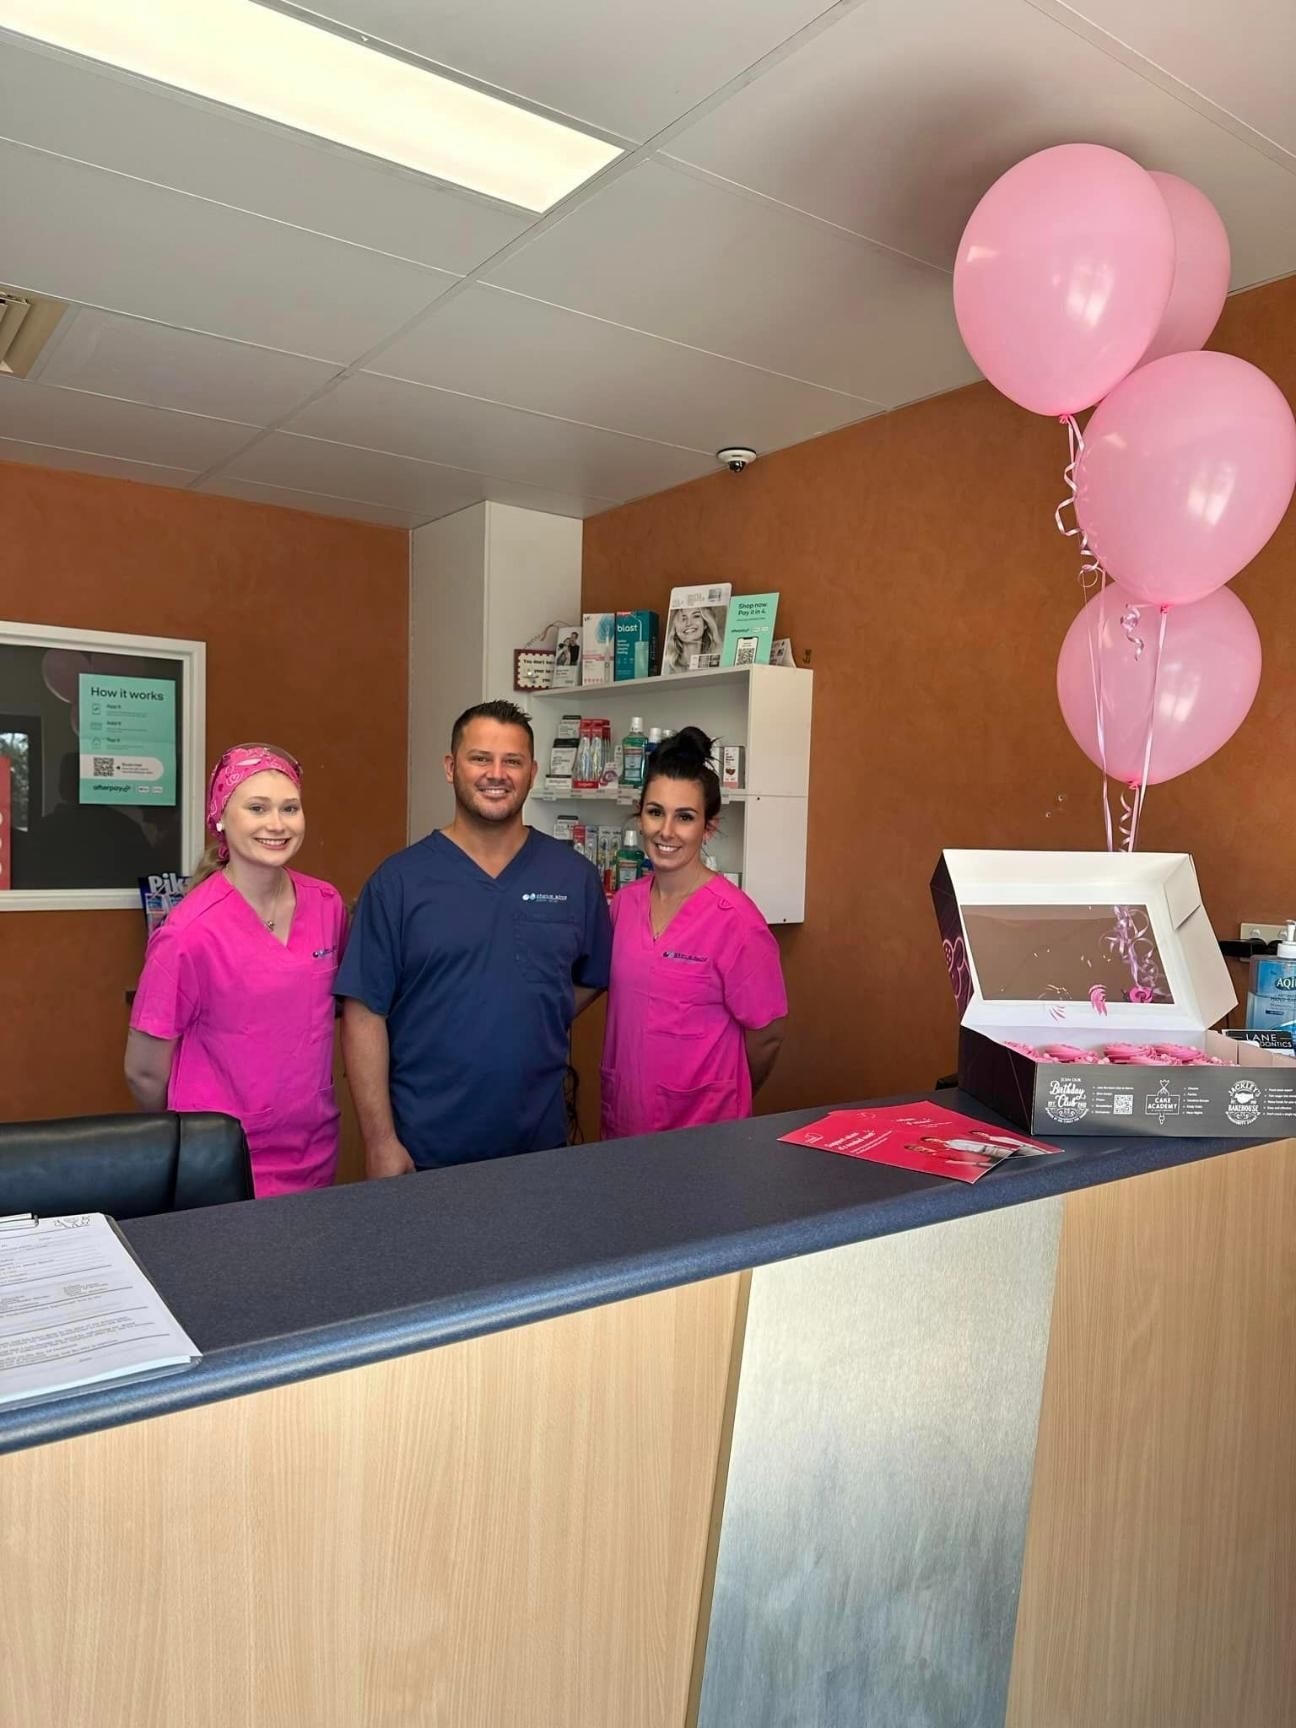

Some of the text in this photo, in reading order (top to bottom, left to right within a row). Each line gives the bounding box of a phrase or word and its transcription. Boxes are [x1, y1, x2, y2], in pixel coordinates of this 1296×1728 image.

[616, 623, 638, 632] blast
[90, 686, 164, 701] How it works
[1246, 1033, 1278, 1042] LANE
[1050, 1080, 1086, 1099] Birthday
[1055, 1094, 1077, 1108] Club
